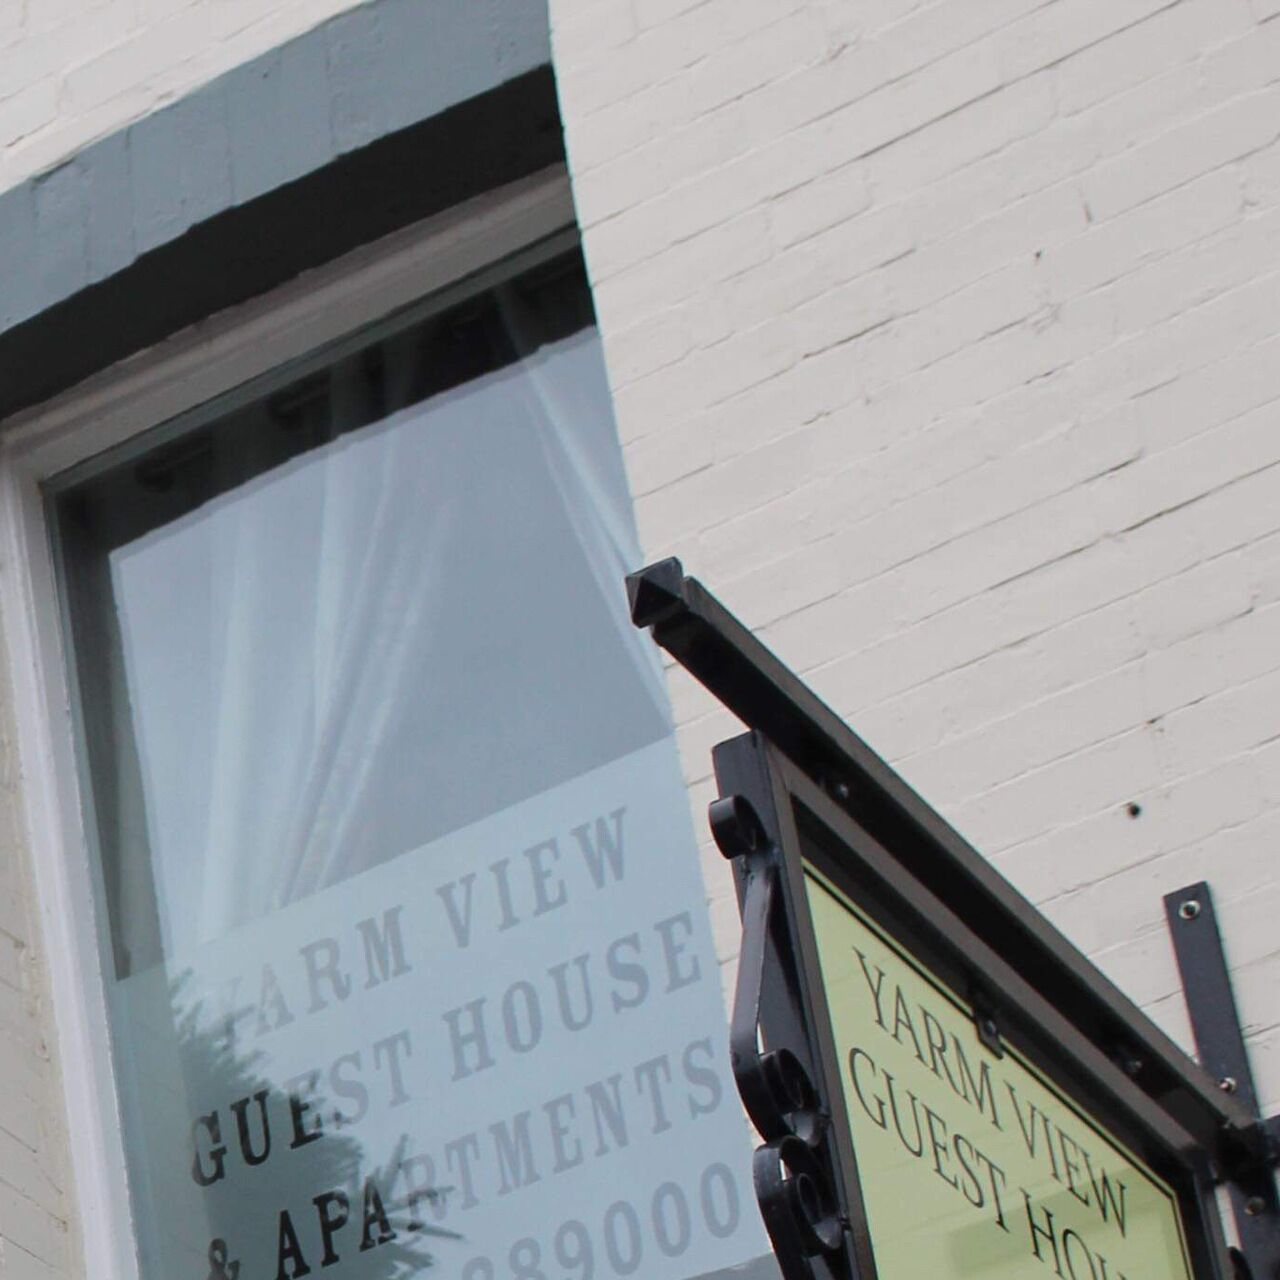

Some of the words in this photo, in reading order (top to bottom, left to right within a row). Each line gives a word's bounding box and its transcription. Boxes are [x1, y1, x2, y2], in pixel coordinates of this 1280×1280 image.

[191, 1031, 412, 1187] GUEST
[443, 911, 702, 1083] HOUSE
[226, 905, 413, 1040] ARM
[436, 806, 628, 949] VIEW
[849, 1047, 1010, 1234] GUEST
[853, 946, 1003, 1132] YARM
[1003, 1079, 1126, 1238] VIEW
